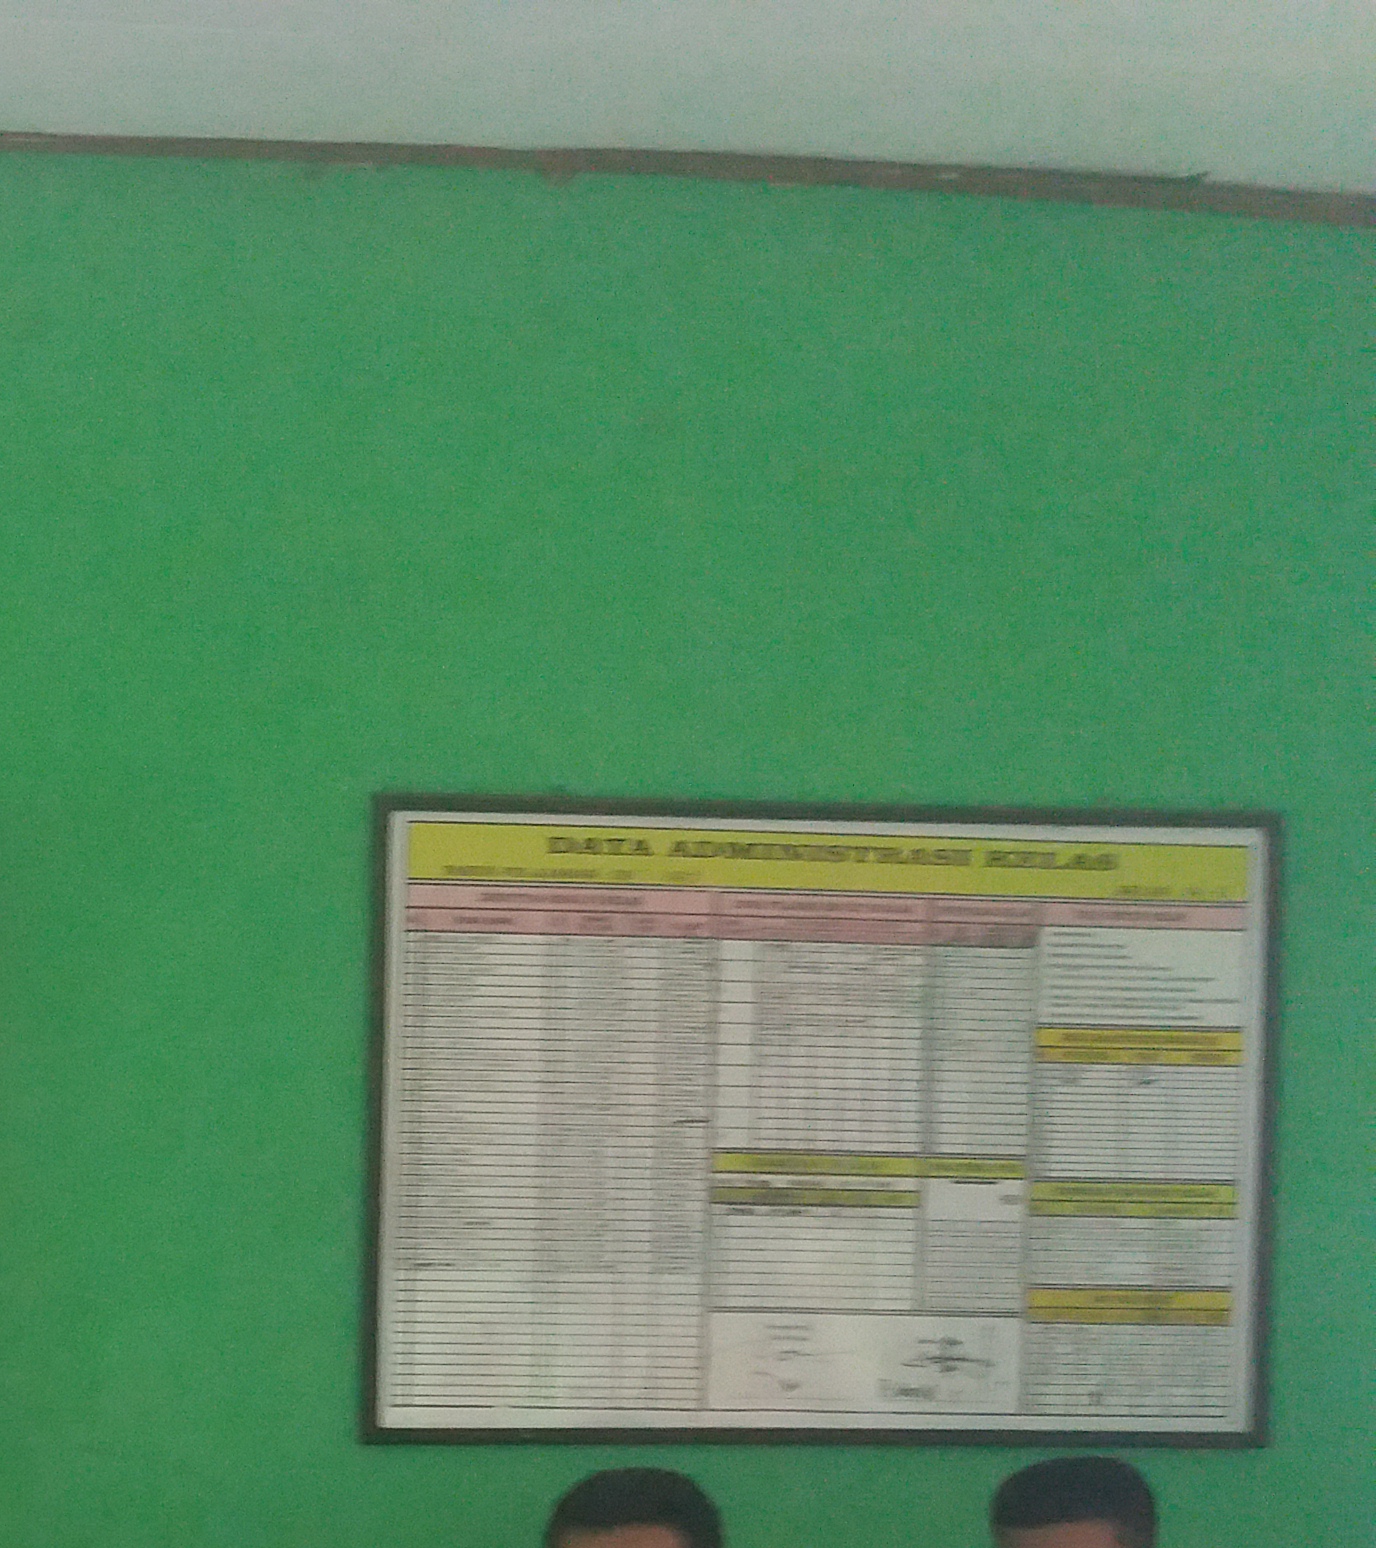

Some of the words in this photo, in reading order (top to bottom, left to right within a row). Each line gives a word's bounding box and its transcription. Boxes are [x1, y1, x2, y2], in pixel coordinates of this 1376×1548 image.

[547, 837, 653, 857] DATA
[668, 841, 973, 866] ADMINISTRASI
[984, 850, 1120, 871] KELAS
